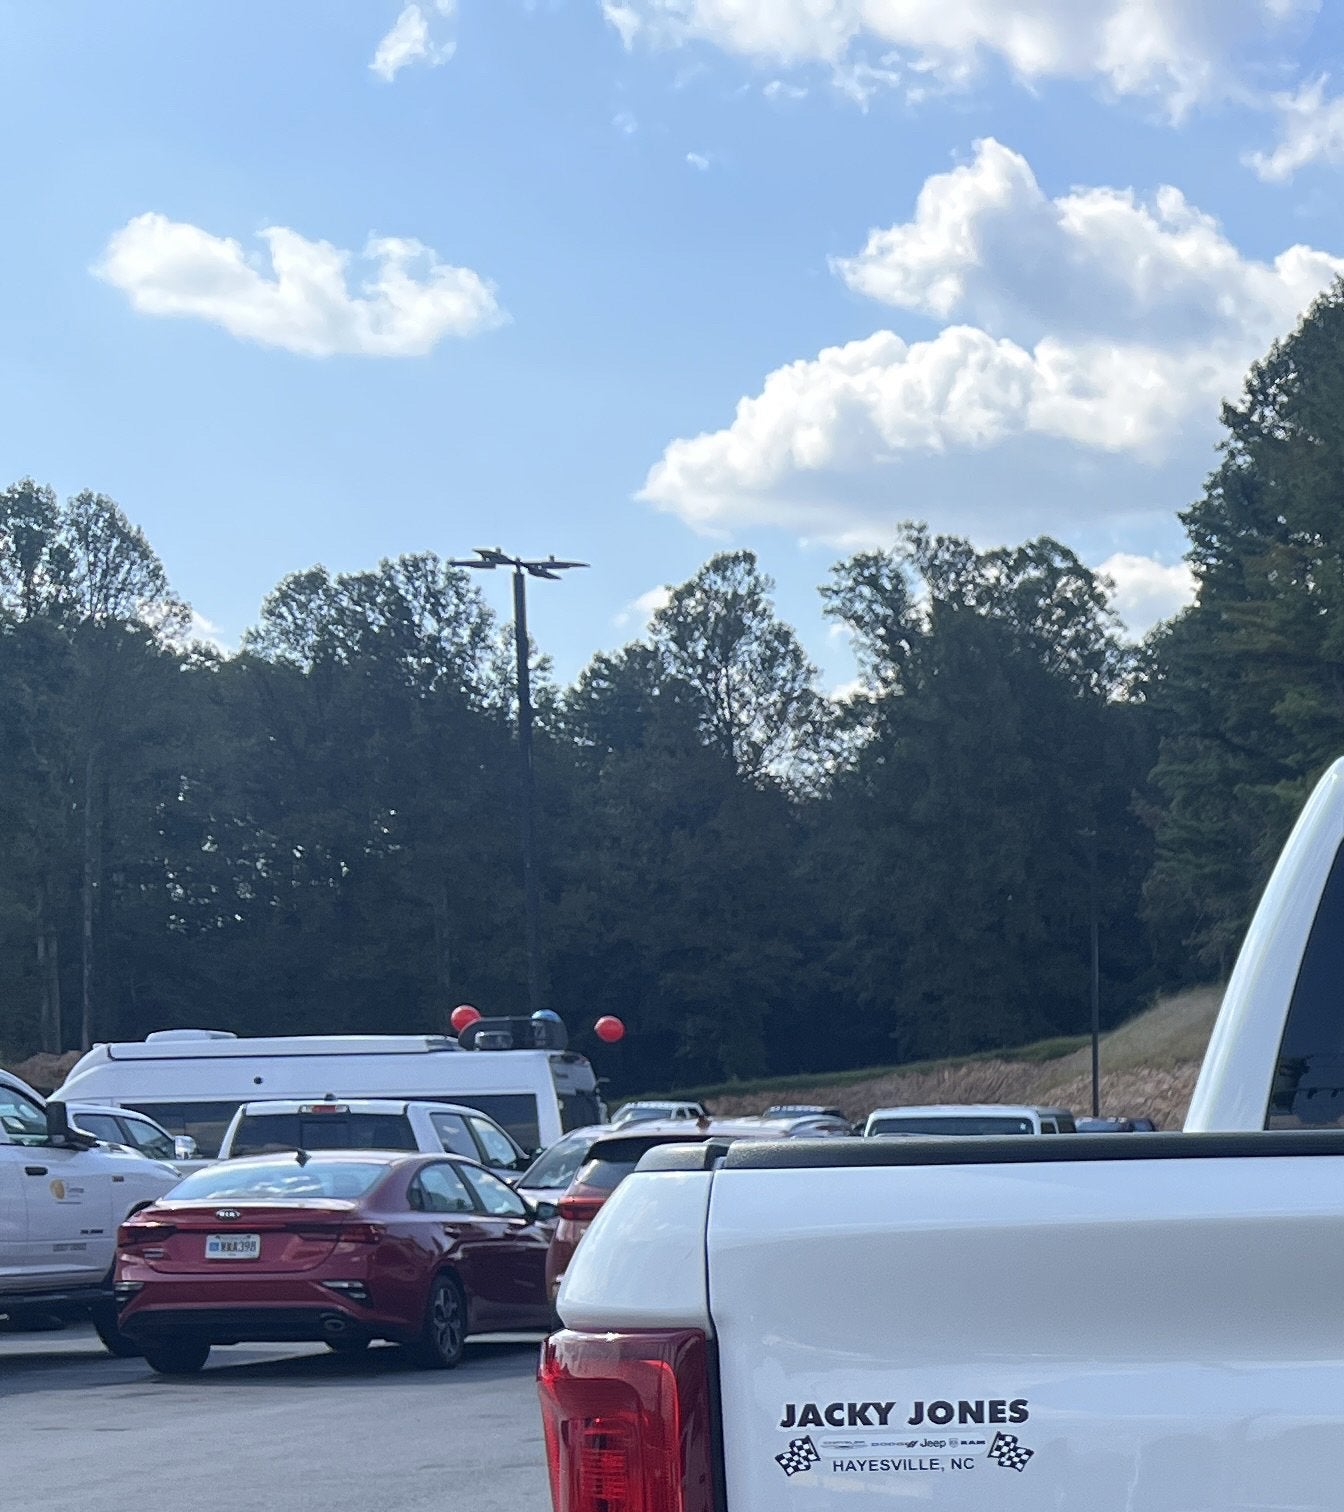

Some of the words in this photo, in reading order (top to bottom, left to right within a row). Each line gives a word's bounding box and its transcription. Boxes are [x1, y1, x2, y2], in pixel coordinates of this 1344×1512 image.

[780, 1402, 897, 1428] JACKY
[908, 1399, 1030, 1426] JONES
[920, 1439, 947, 1450] Jeep
[833, 1459, 946, 1473] HAYESVILLE,
[951, 1458, 976, 1470] NC
